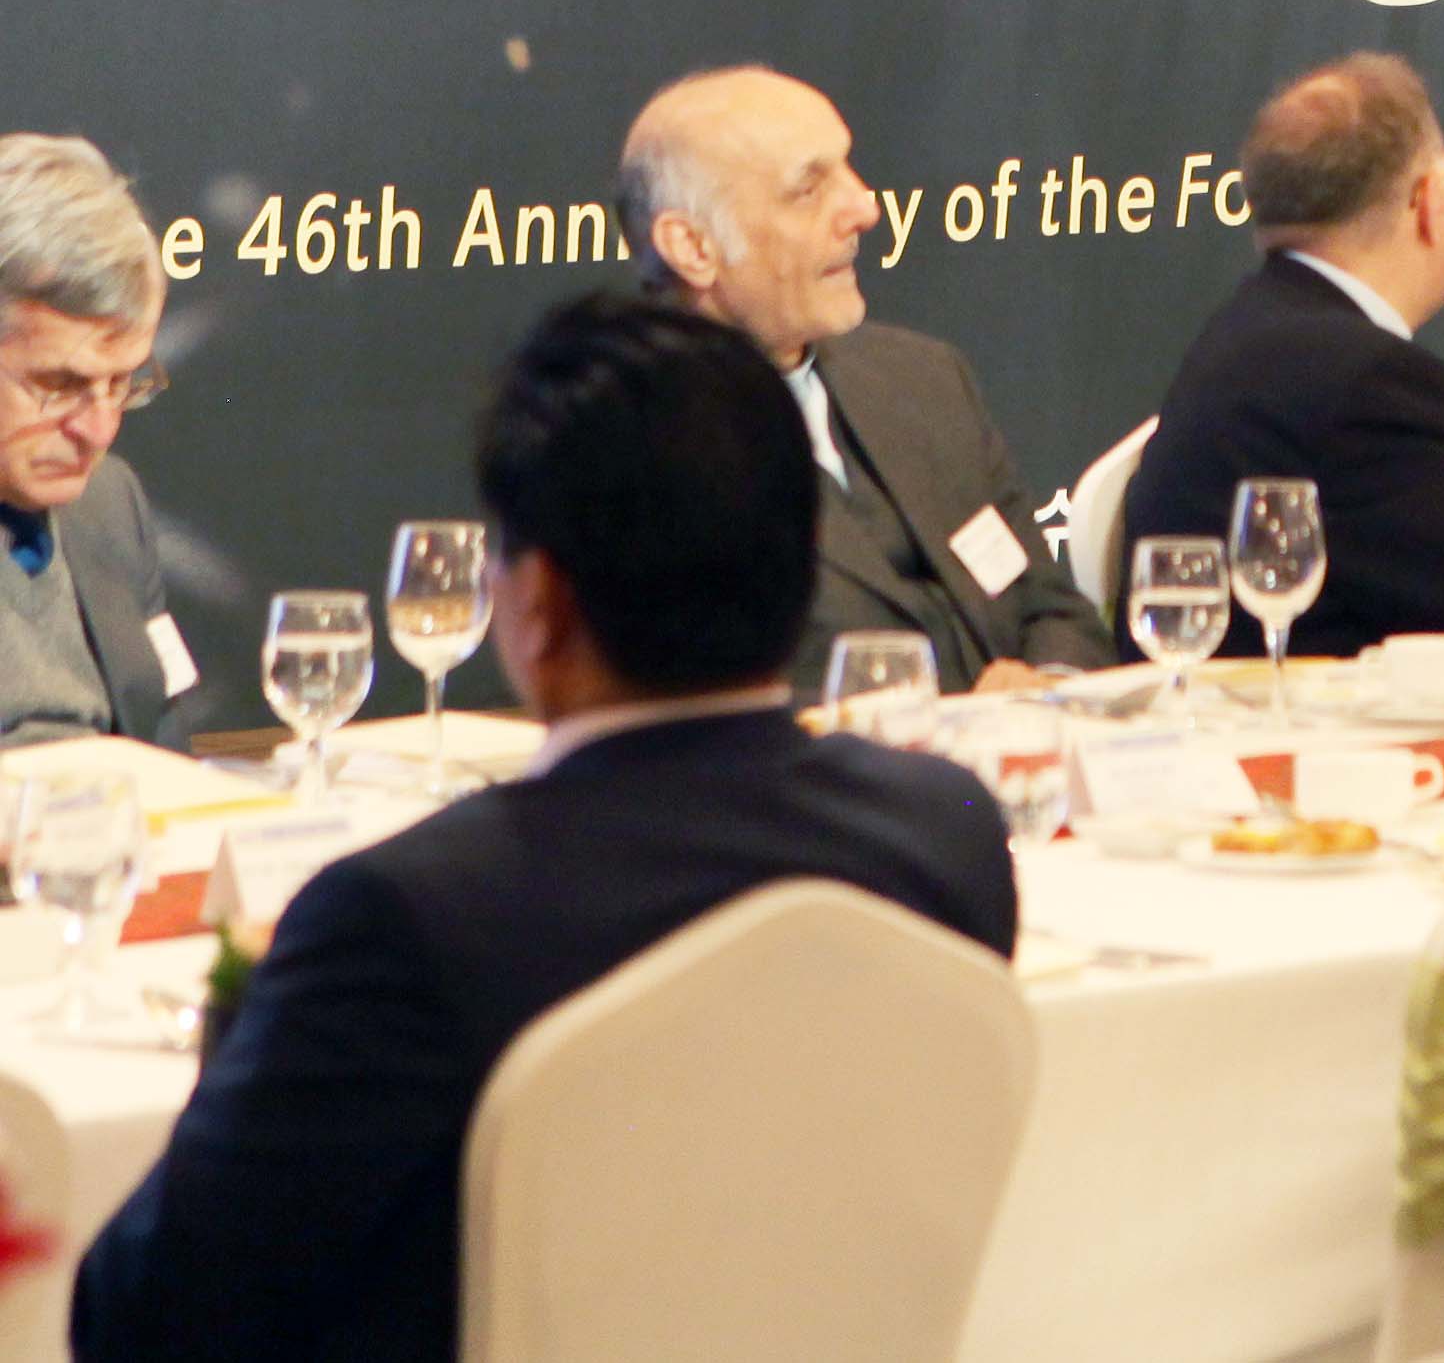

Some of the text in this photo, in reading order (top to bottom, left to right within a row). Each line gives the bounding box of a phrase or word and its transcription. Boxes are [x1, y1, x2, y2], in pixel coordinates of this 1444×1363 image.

[237, 185, 421, 276] 46th
[944, 159, 1021, 242] of
[1040, 155, 1155, 237] the
